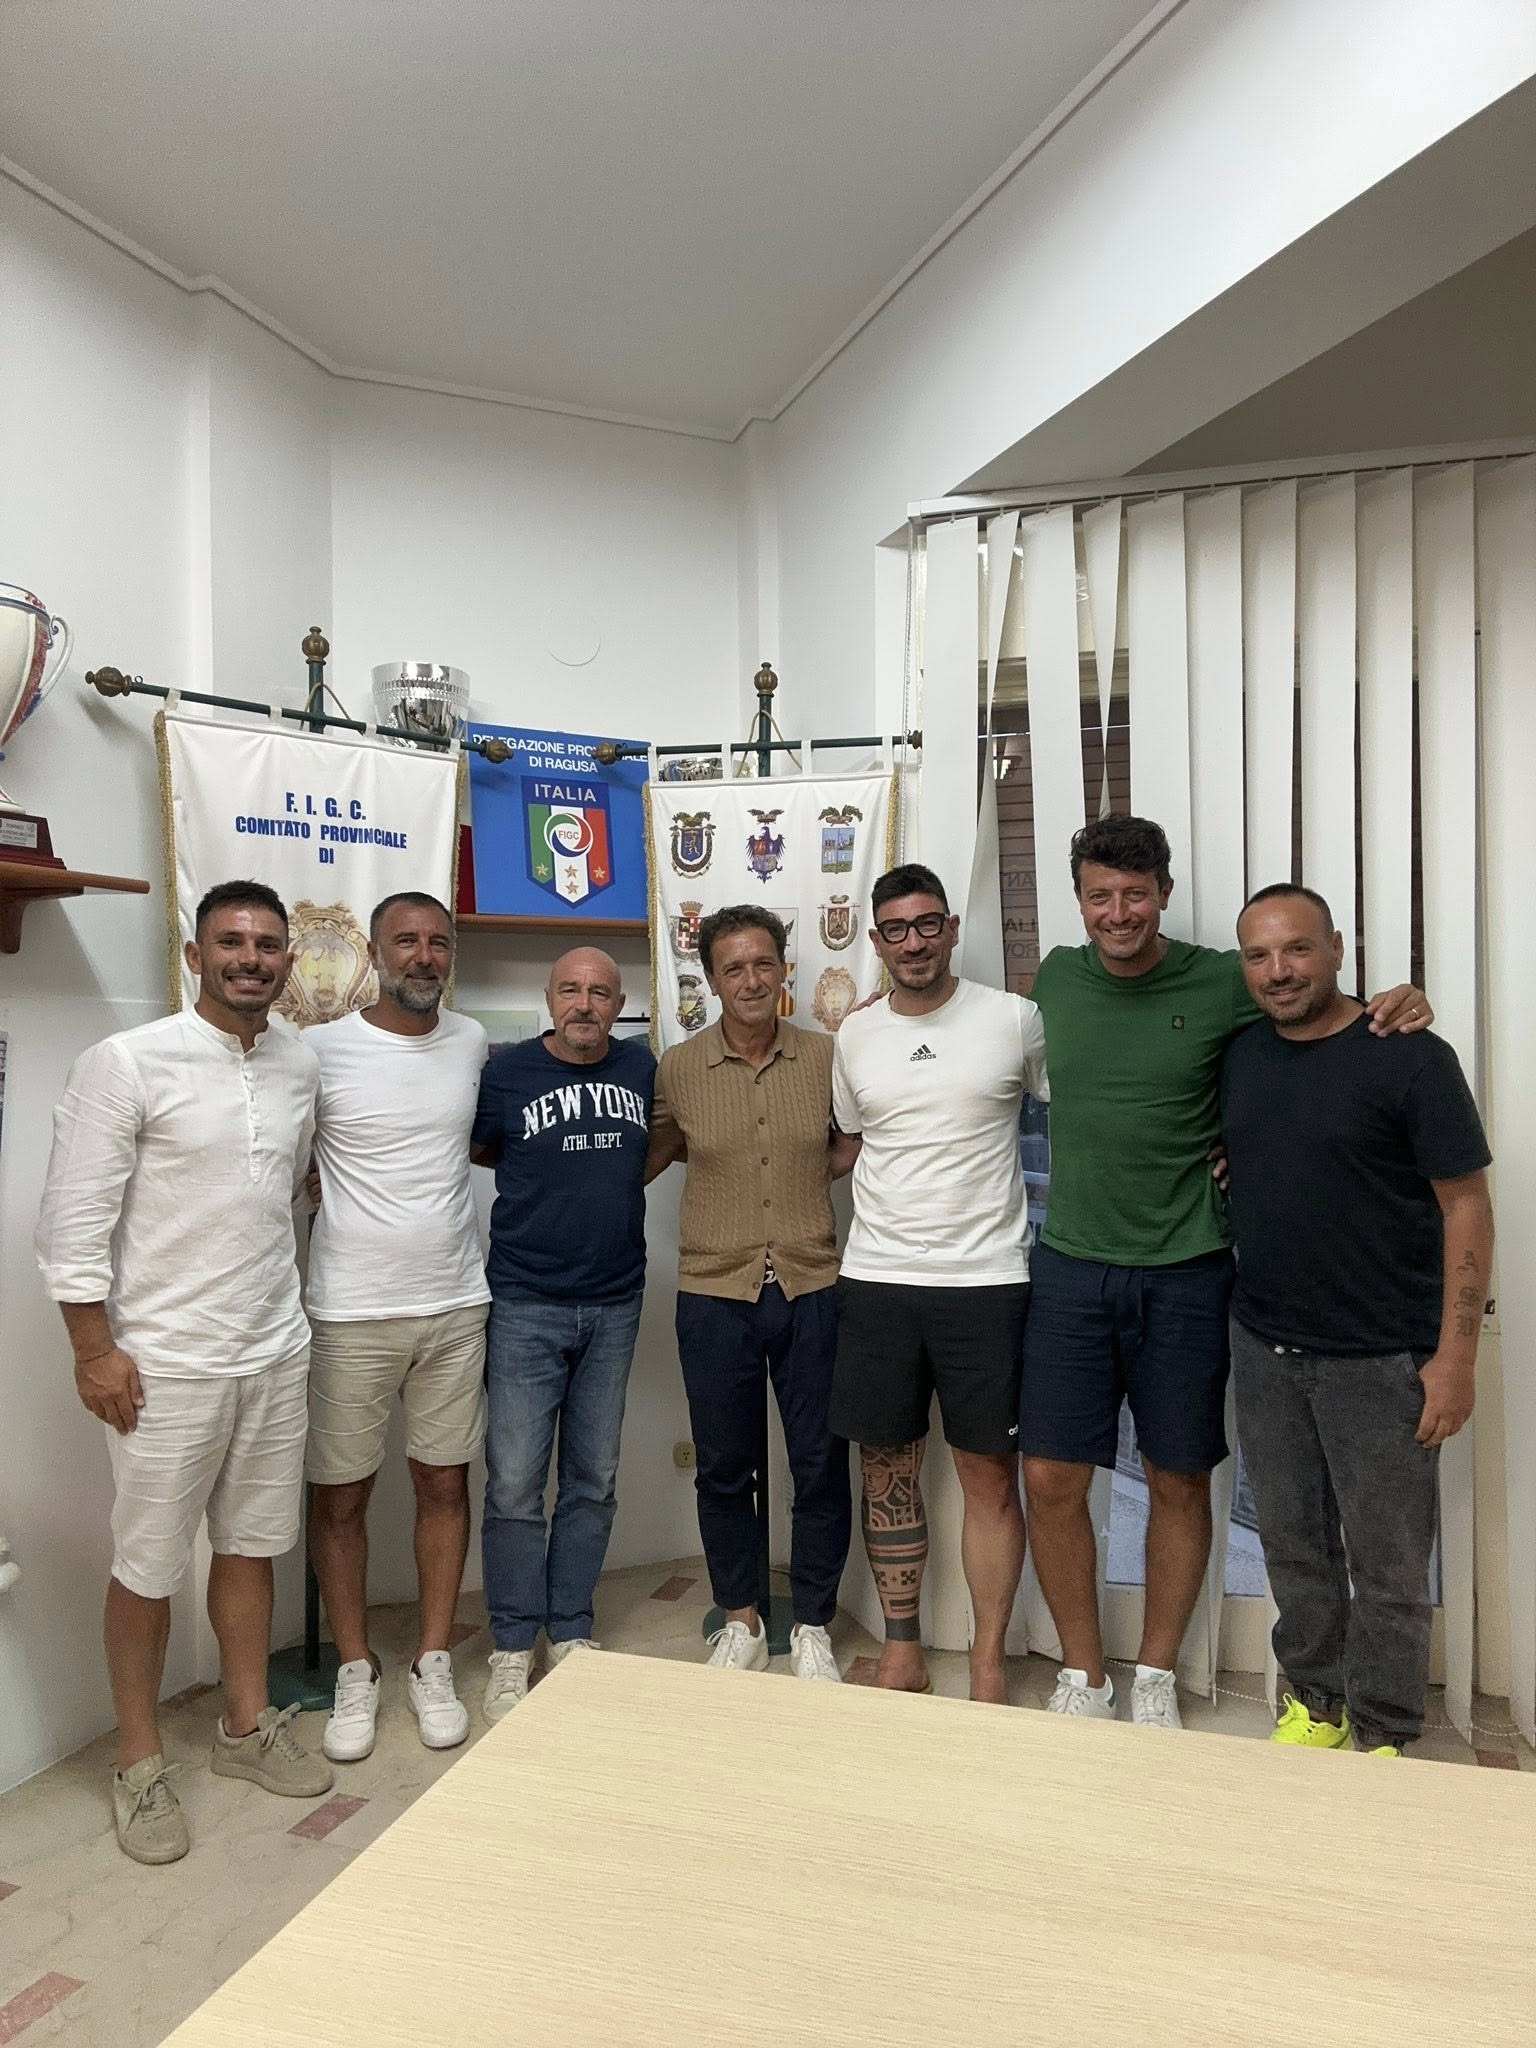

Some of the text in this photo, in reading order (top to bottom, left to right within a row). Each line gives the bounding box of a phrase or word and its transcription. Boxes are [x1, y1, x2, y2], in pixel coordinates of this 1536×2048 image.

[528, 756, 598, 773] DI RAGUSA
[534, 783, 597, 802] ITALIA
[235, 816, 407, 849] COMITATO PROVINCIALE
[558, 830, 580, 841] FIGC
[319, 847, 334, 864] DI
[910, 1053, 936, 1062] adidas
[522, 1083, 648, 1140] NEW YORK
[594, 1132, 622, 1149] DEPT.
